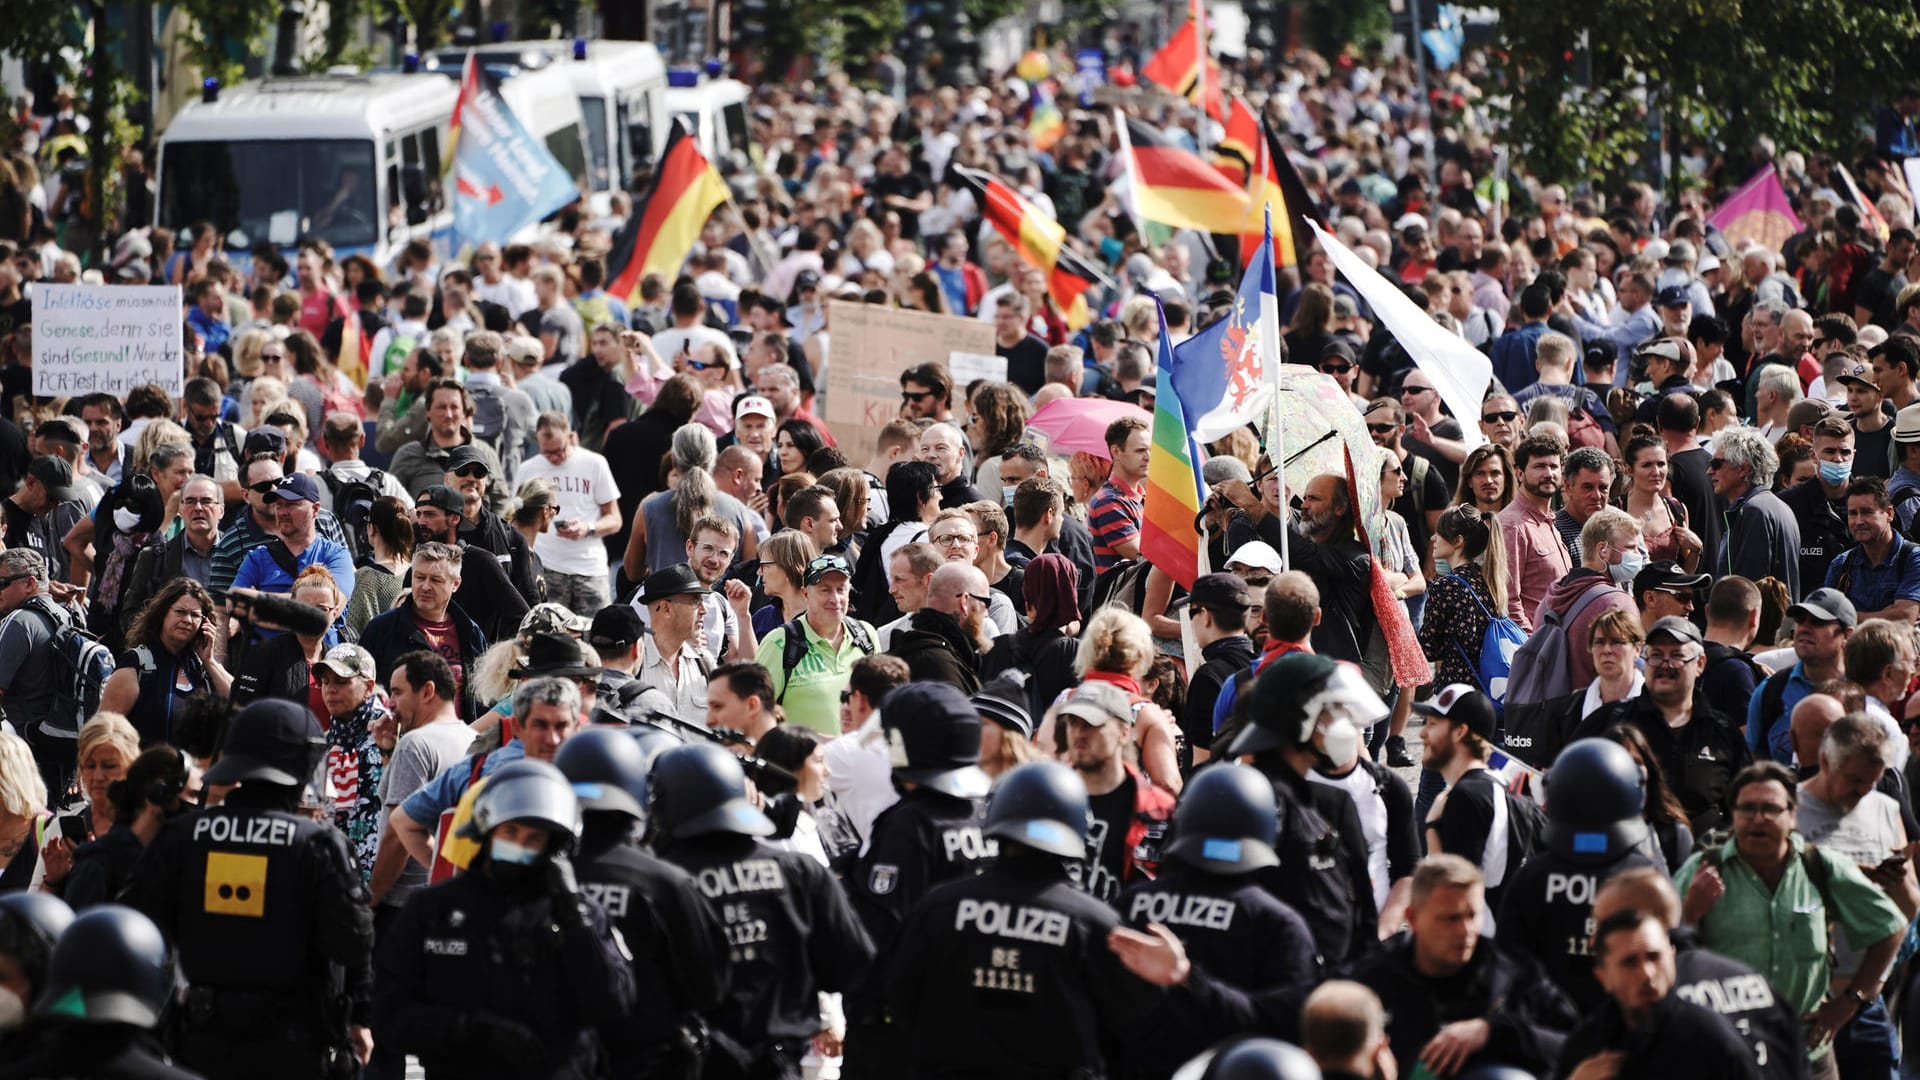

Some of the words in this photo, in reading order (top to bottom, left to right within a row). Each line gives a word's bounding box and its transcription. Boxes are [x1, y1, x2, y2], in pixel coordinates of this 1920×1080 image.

[147, 322, 174, 338] sie
[40, 348, 70, 366] sind
[133, 346, 157, 363] Nur
[158, 342, 179, 363] der
[101, 371, 121, 391] der
[1800, 547, 1824, 556] OLIZEI
[1504, 734, 1533, 748] didas
[193, 815, 296, 847] POLIZEI
[695, 859, 785, 898] OLIZEI
[954, 899, 1071, 947] POLIZEI
[1128, 891, 1236, 931] POLIZEI
[991, 948, 1020, 969] BE
[973, 968, 1034, 993] 11111
